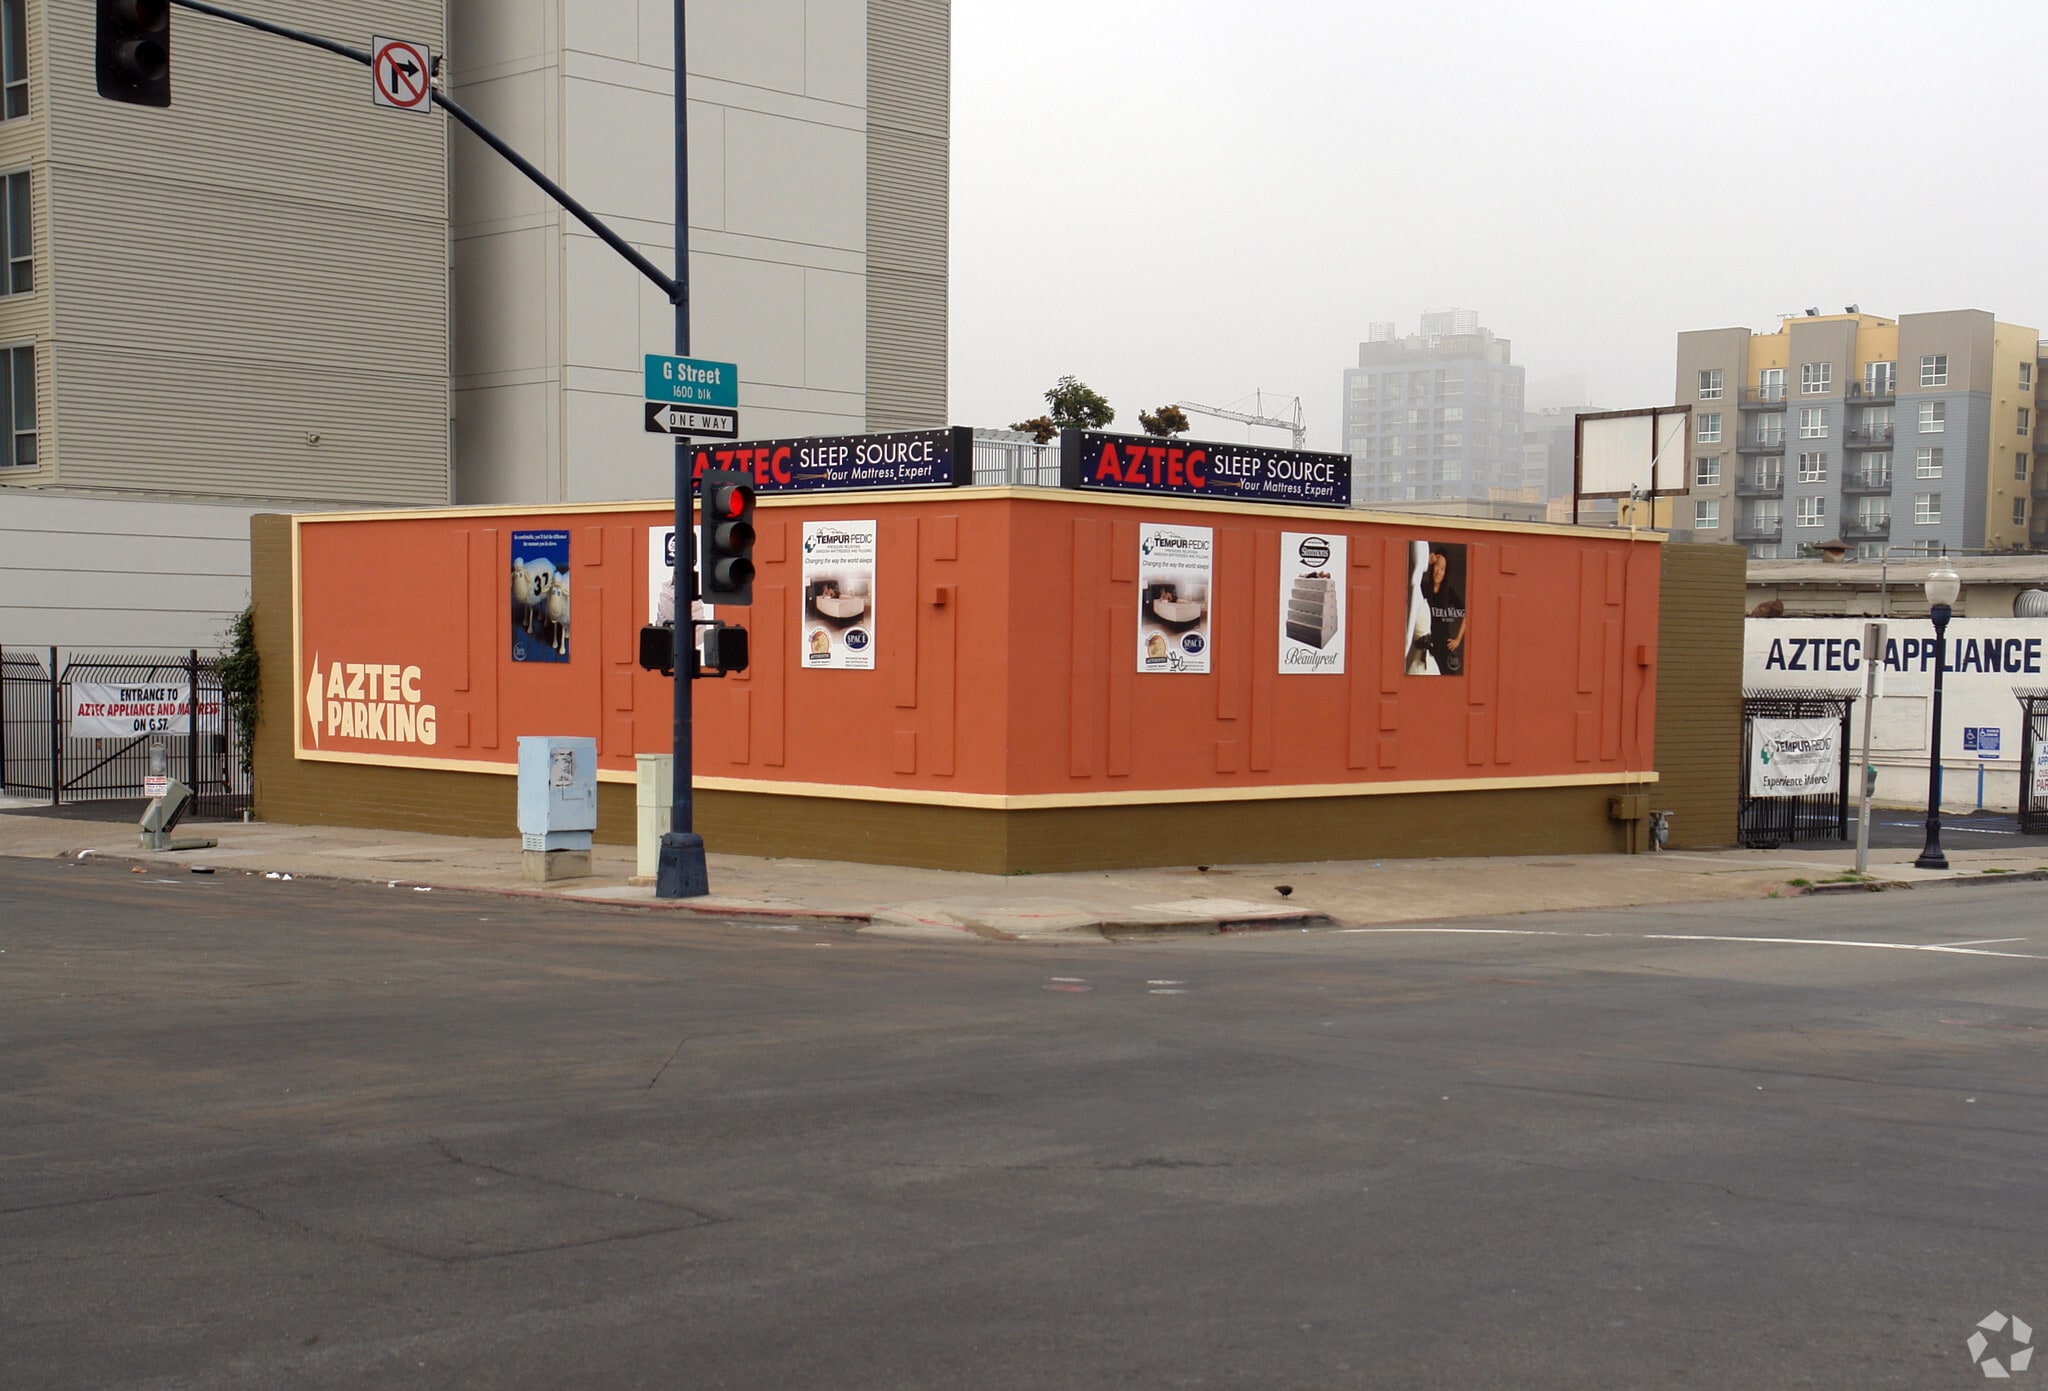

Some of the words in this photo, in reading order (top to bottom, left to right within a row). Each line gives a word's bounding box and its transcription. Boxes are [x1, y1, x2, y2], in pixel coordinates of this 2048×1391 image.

[663, 361, 673, 380] G
[677, 363, 721, 385] Street
[673, 385, 693, 398] 1600
[698, 388, 711, 400] blk
[670, 413, 695, 427] ONE
[702, 416, 727, 430] WAY
[800, 446, 849, 468] SLEEP
[855, 440, 934, 465] SOURCE
[826, 468, 848, 482] Your
[851, 466, 894, 480] Mattress
[899, 464, 932, 480] Expert
[1096, 442, 1207, 489] AZTEC
[1214, 454, 1261, 477] SLEEP
[1267, 459, 1335, 483] SOURCE
[1240, 477, 1260, 492] Your
[1263, 480, 1301, 495] Mattress
[1304, 485, 1334, 498] Expert
[816, 534, 850, 544] TEMPUR
[534, 572, 549, 596] 37
[1431, 606, 1447, 618] VERA
[1447, 607, 1466, 618] WANG
[1284, 647, 1339, 672] Beautyrest
[1765, 638, 1861, 671] AZTEC
[1883, 638, 2042, 673] APPLIANCE
[326, 661, 421, 703] AZTEC
[120, 688, 165, 701] ENTRANCE
[167, 688, 178, 701] TO
[78, 703, 105, 717] AZTEC
[107, 703, 155, 717] APPLIANCE
[157, 702, 176, 716] AND
[133, 718, 146, 731] ON
[149, 719, 156, 731] G
[157, 719, 169, 731] ST.
[327, 700, 437, 745] PARKING
[1775, 740, 1811, 752] TEMPUR
[1763, 775, 1803, 790] Experience
